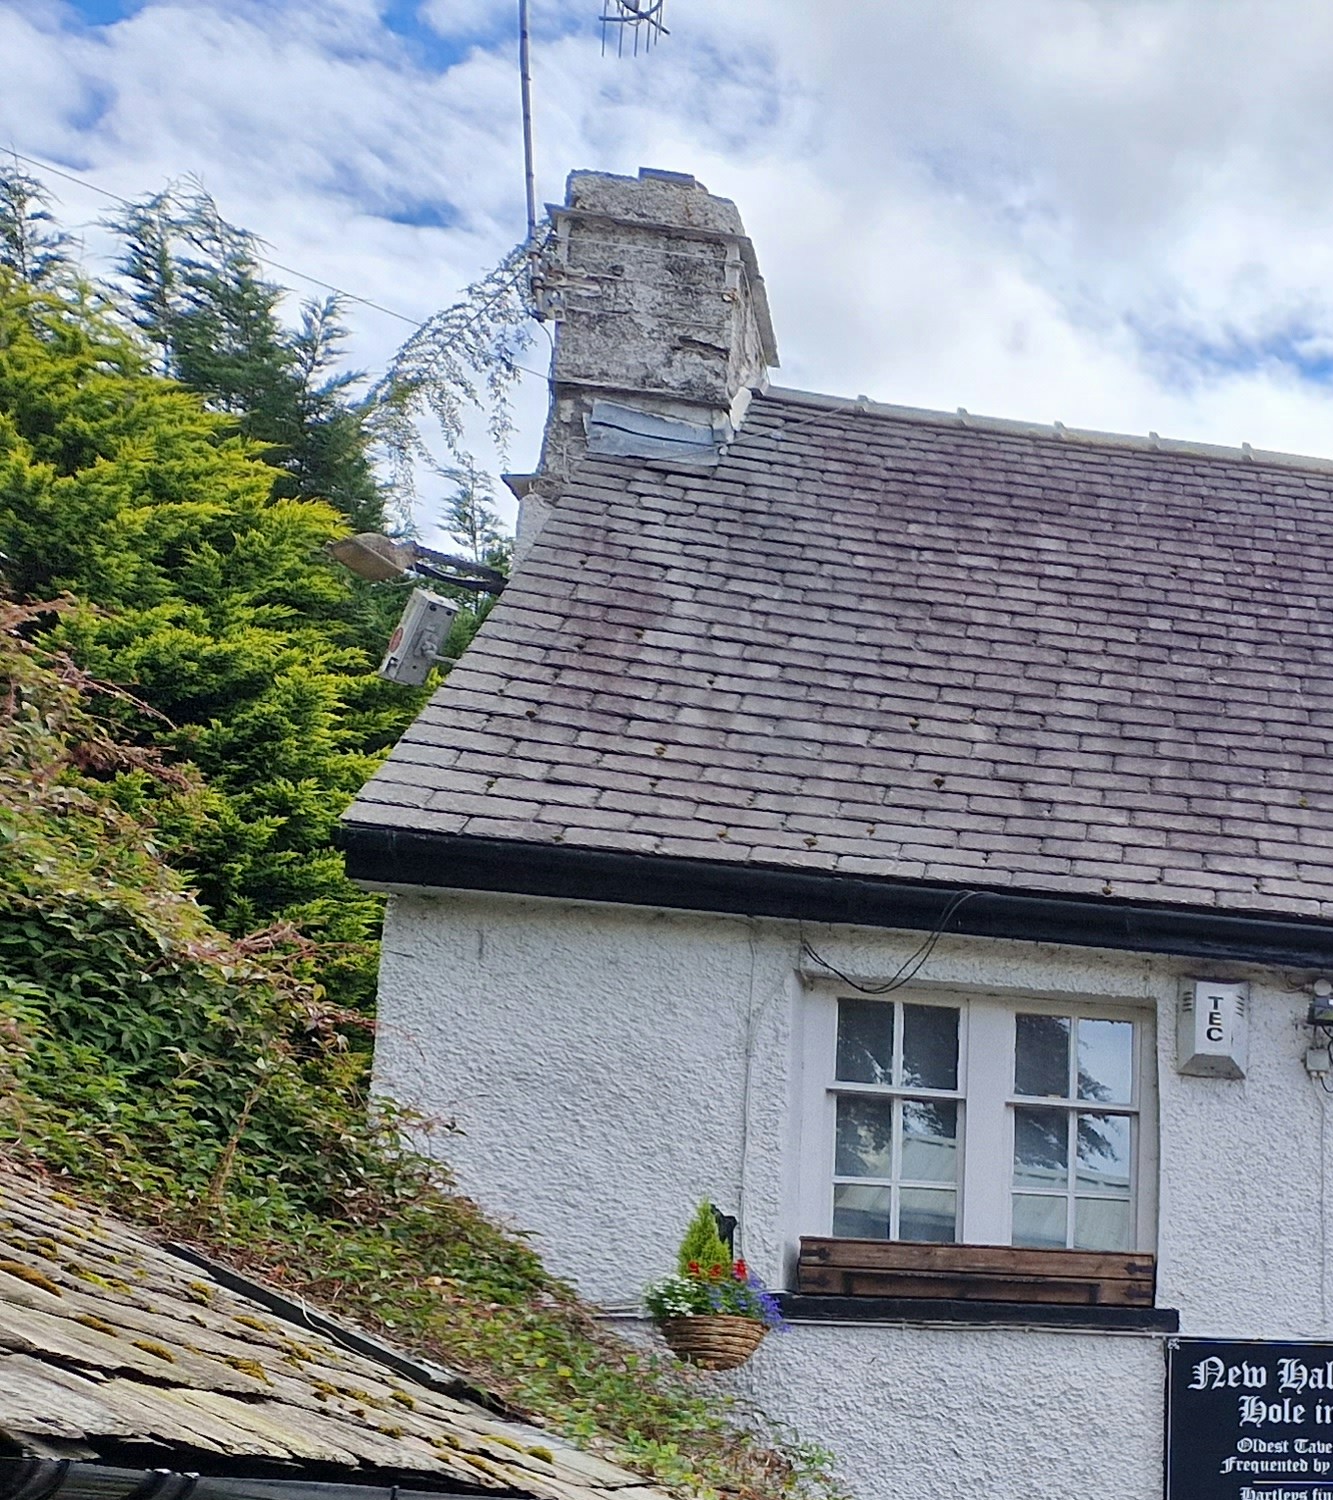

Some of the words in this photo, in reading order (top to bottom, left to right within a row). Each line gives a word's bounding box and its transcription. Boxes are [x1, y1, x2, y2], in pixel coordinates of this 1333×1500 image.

[1207, 995, 1224, 1042] TEC
[1187, 1356, 1267, 1390] New
[1238, 1395, 1306, 1428] Hole
[1237, 1437, 1289, 1453] Oldest
[1219, 1456, 1309, 1474] Frequented
[1313, 1458, 1331, 1475] by
